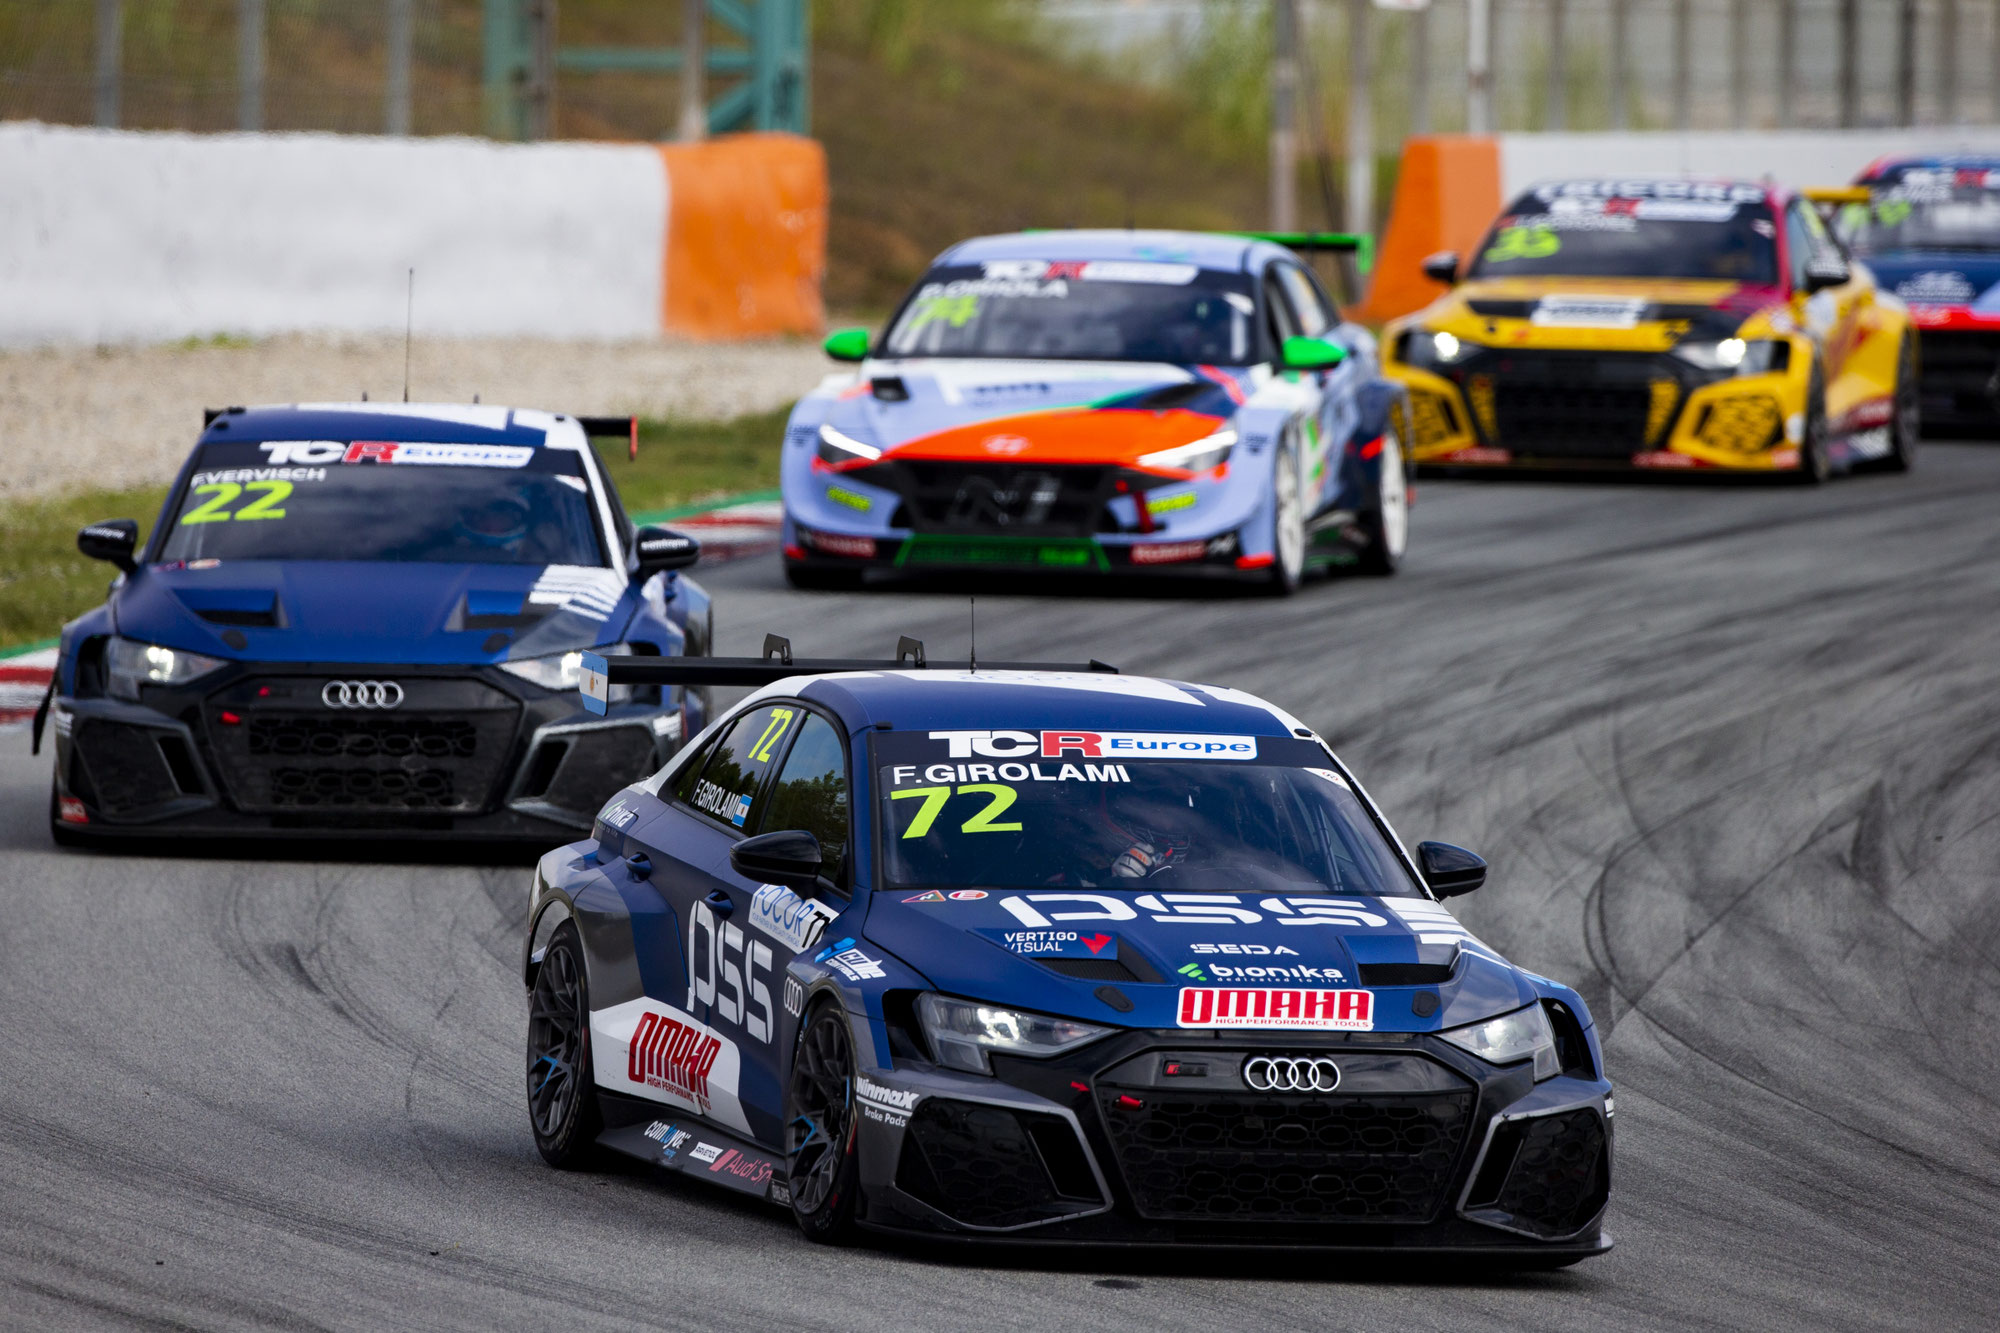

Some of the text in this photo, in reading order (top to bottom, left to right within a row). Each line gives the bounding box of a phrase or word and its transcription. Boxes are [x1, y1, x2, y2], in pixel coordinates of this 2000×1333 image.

[259, 441, 527, 464] TCR Europe
[181, 480, 293, 525] 22
[748, 708, 793, 763] 72
[929, 731, 1252, 757] TCR Europe
[893, 763, 1131, 784] F.GIROLAMI
[691, 778, 742, 820] F.GIROLAMI
[890, 784, 1022, 839] 72
[1004, 931, 1077, 942] VERTIGO
[1190, 943, 1300, 956] SEDA
[1209, 963, 1343, 978] bionika
[1181, 988, 1370, 1024] OMAHA
[1246, 1018, 1329, 1027] PERFORMANCE
[1334, 1020, 1369, 1028] TOOLS
[647, 1075, 662, 1089] HIGH
[864, 1106, 906, 1128] Brake Pads
[723, 1153, 762, 1178] Audi
